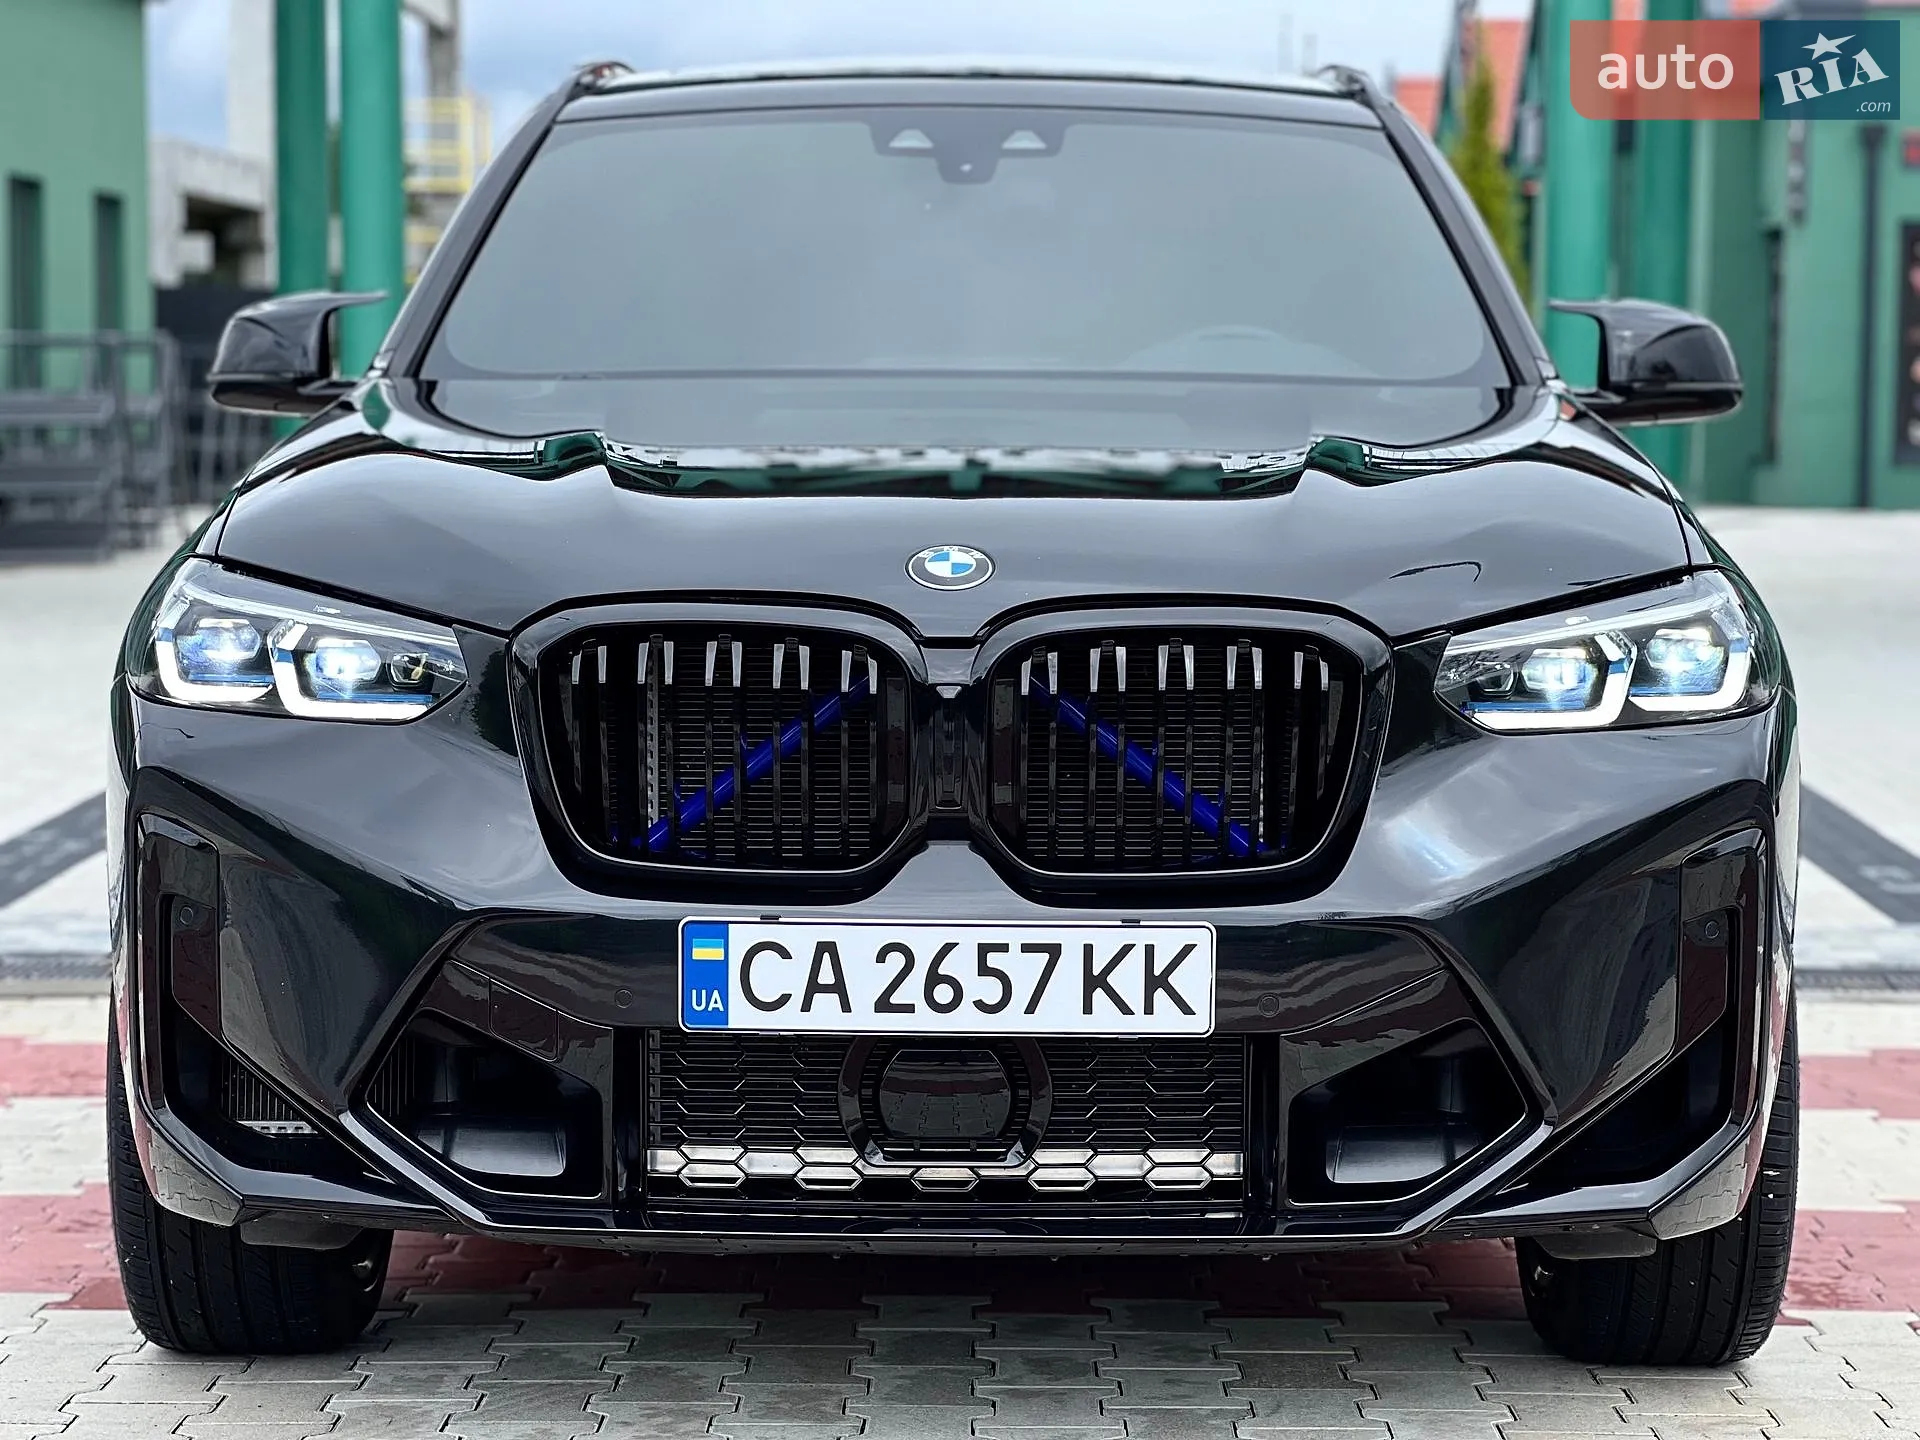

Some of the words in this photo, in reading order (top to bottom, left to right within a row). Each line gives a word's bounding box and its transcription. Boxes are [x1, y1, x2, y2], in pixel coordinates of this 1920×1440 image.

[691, 989, 725, 1012] UA
[739, 940, 853, 1014] CA
[873, 941, 1063, 1015] 2657
[1082, 943, 1198, 1016] KK
